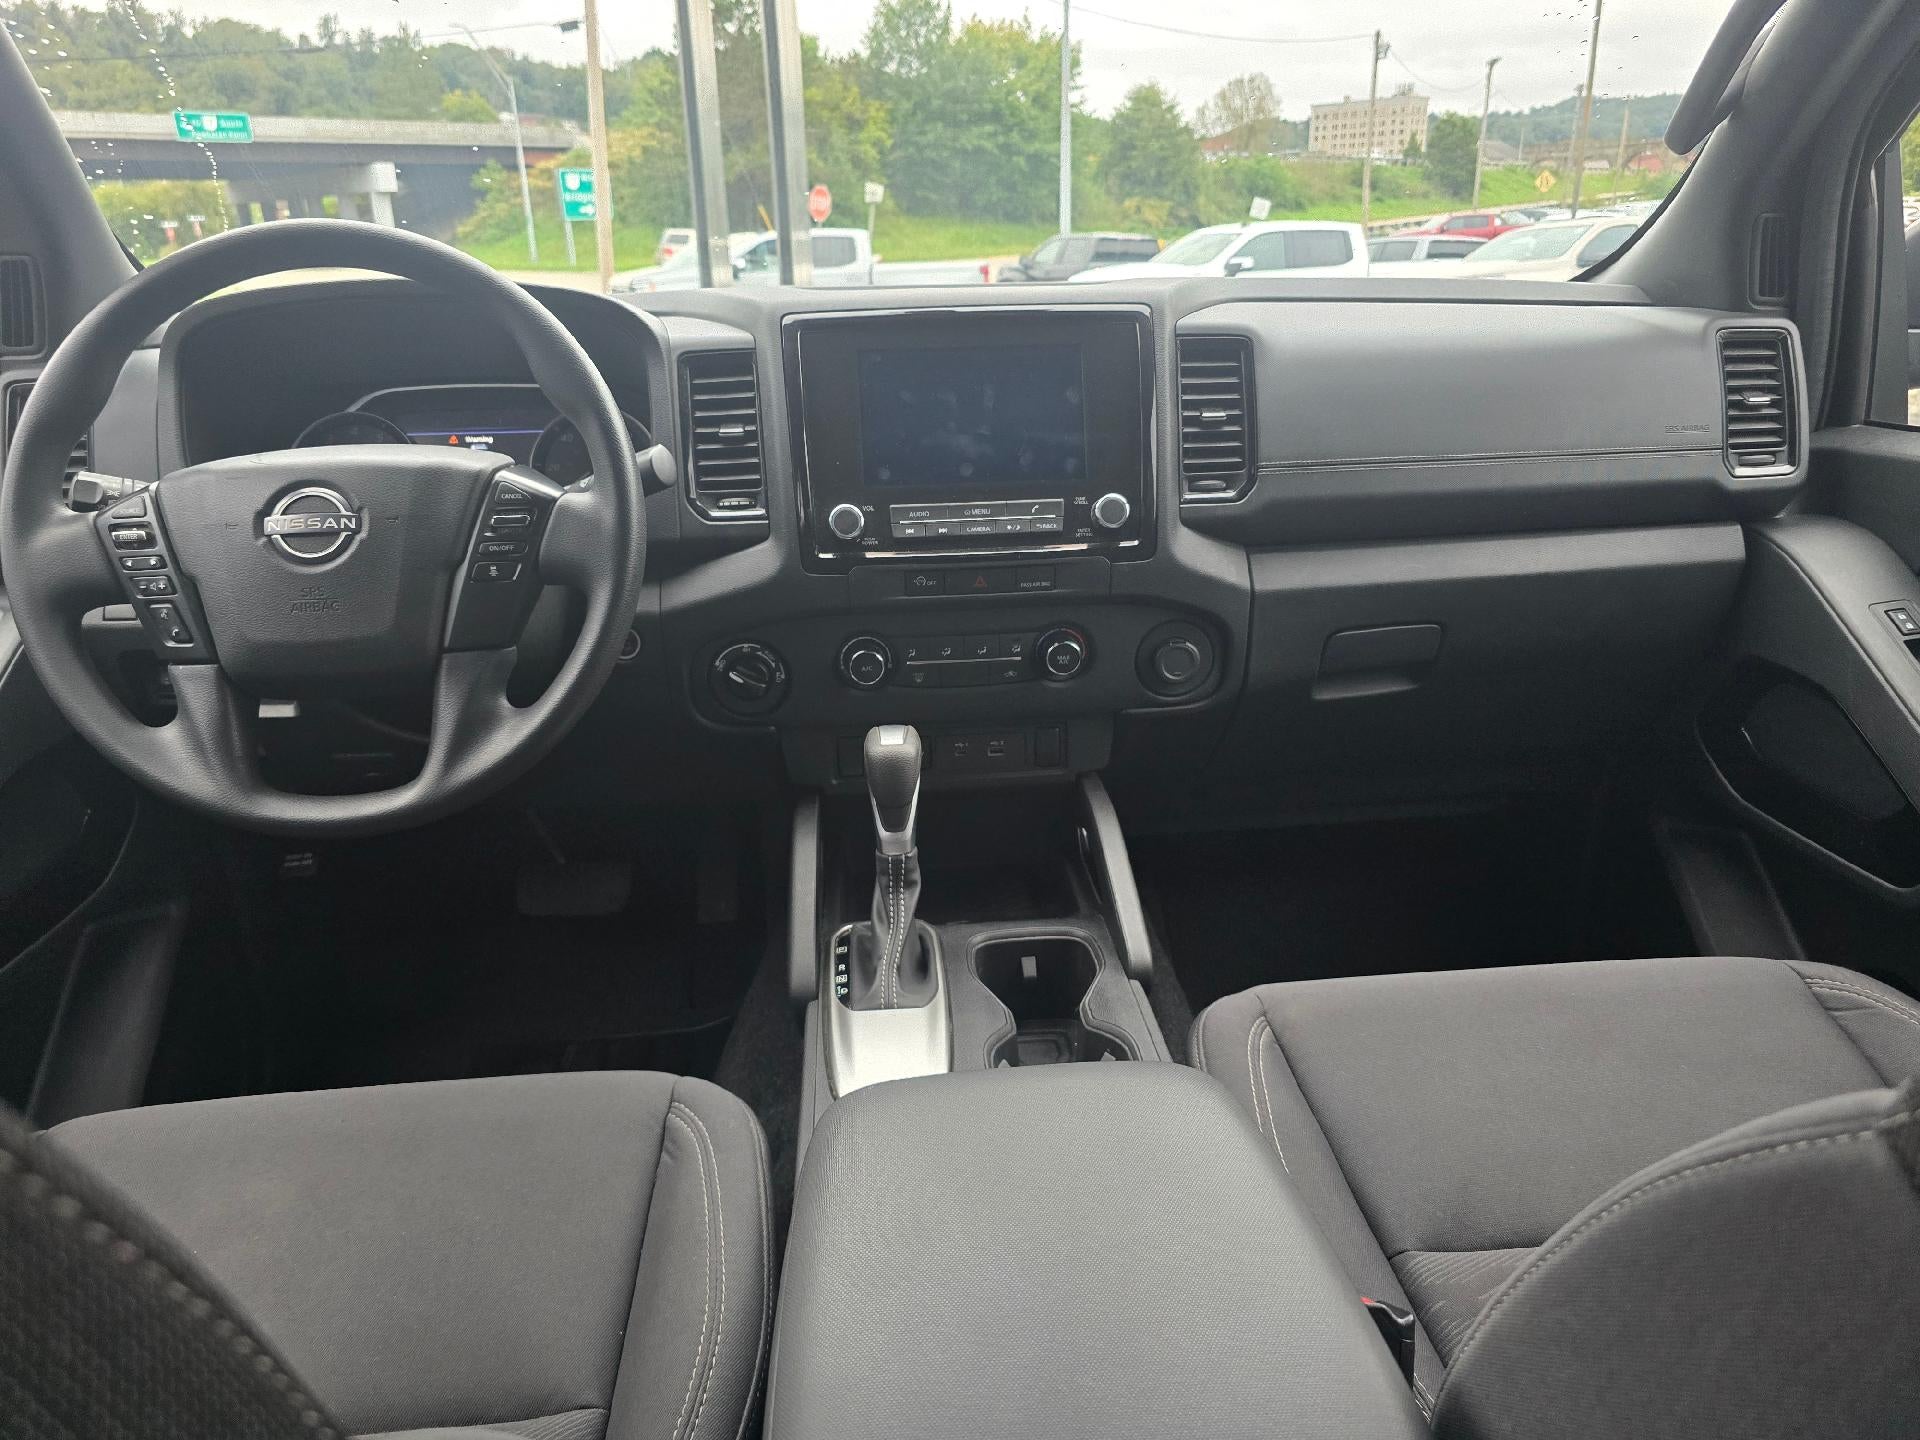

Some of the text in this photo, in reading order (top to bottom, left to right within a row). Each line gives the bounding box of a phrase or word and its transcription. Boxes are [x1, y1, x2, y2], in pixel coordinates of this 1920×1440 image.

[267, 517, 357, 532] NISSAN
[301, 586, 325, 597] SRS
[290, 600, 341, 613] AIRBAG
